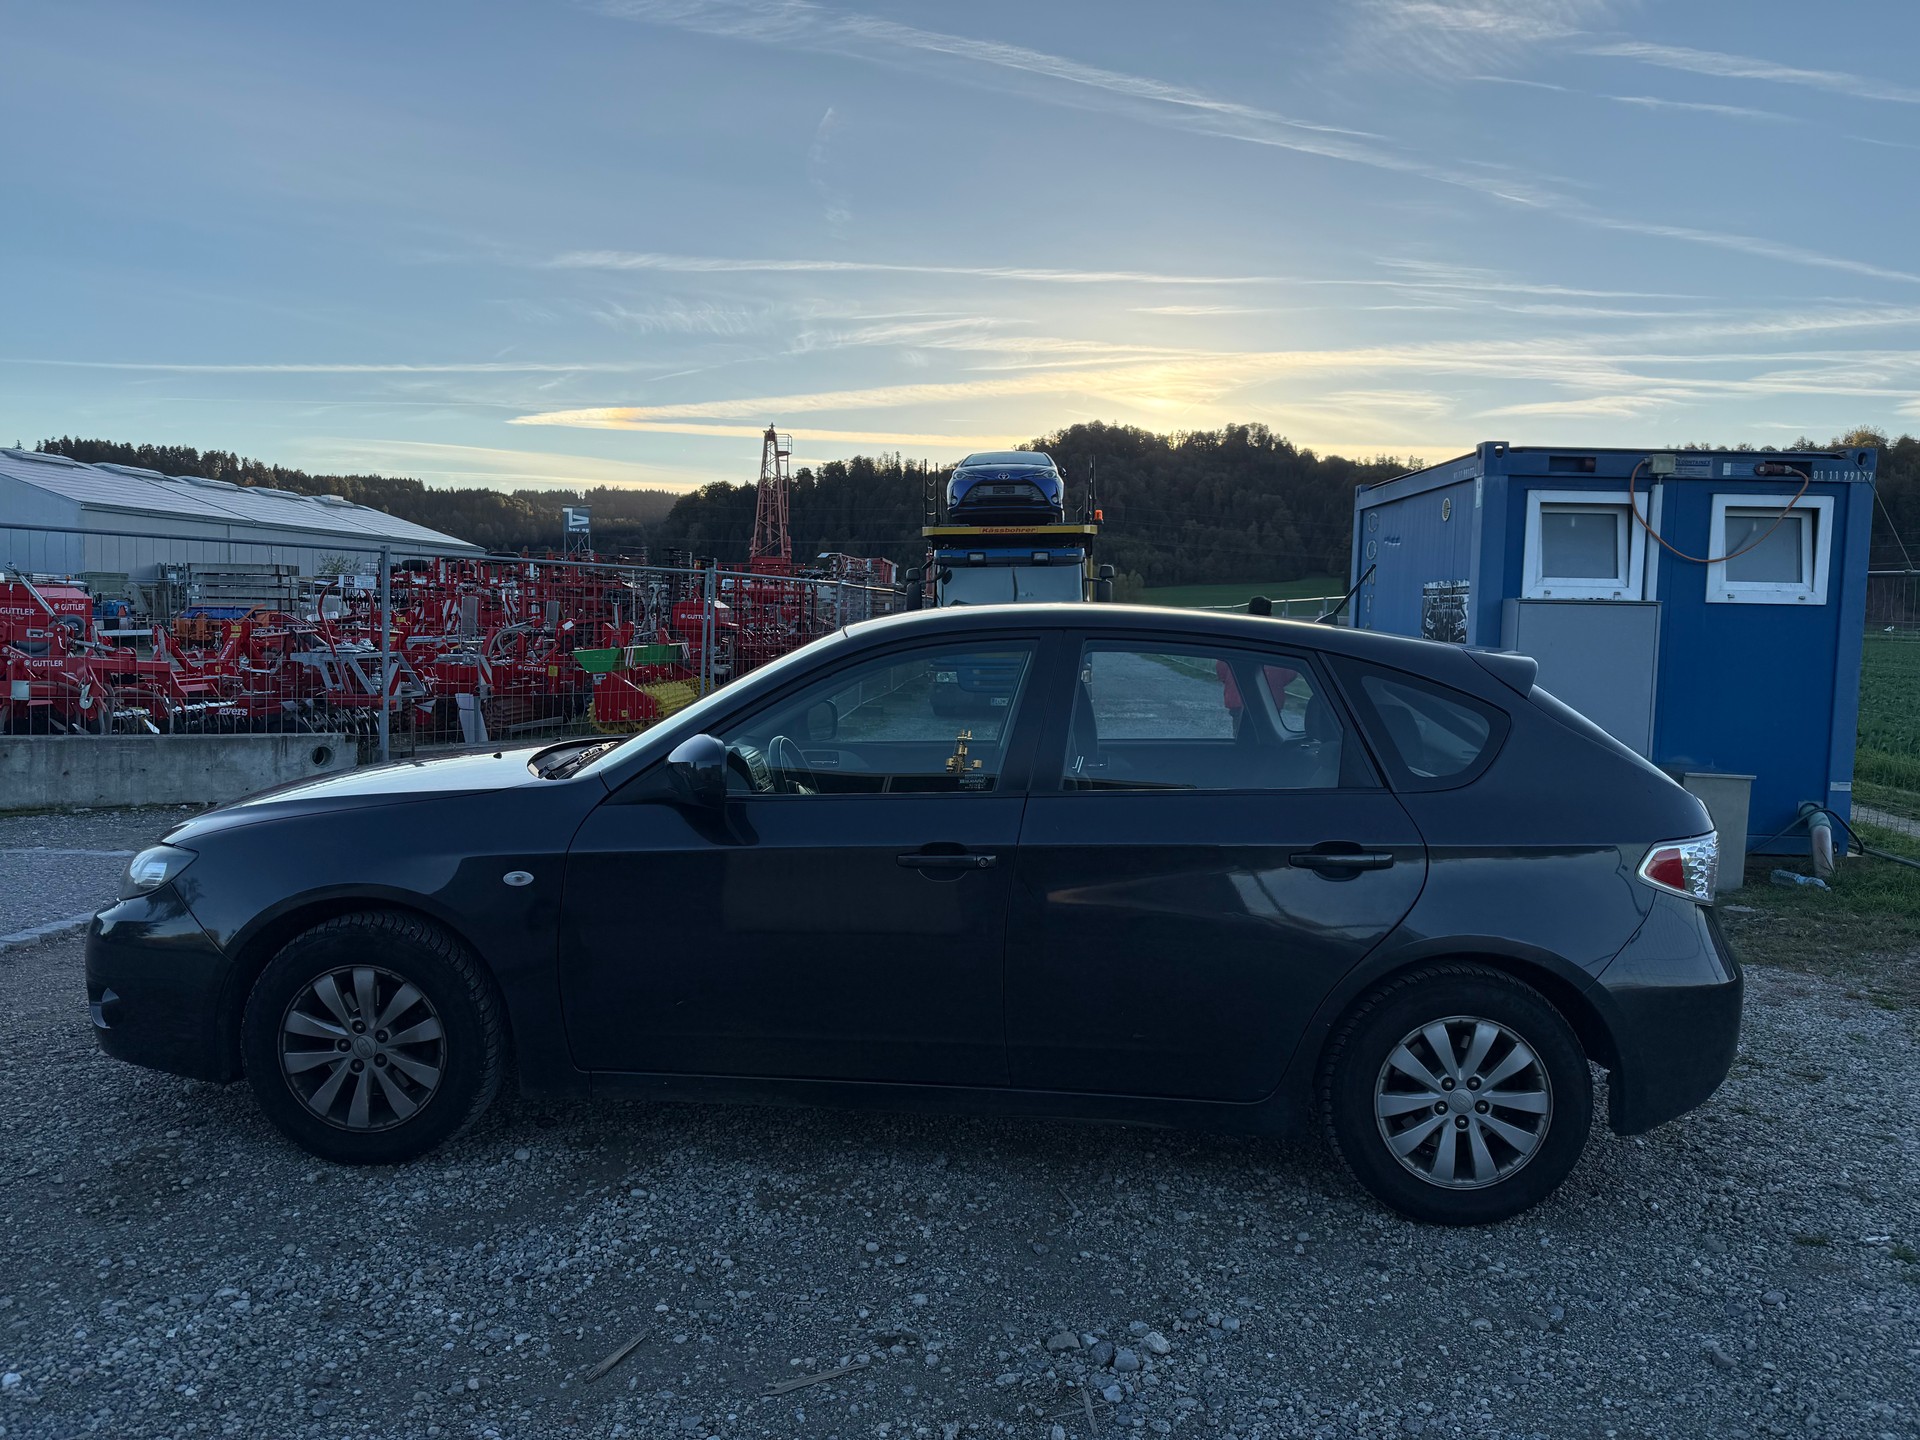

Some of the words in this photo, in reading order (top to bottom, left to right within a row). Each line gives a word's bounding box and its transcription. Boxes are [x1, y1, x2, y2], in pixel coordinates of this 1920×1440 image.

[1814, 470, 1824, 480] 01
[1829, 470, 1839, 480] 11
[1844, 471, 1874, 481] 99177
[219, 707, 248, 716] evers
